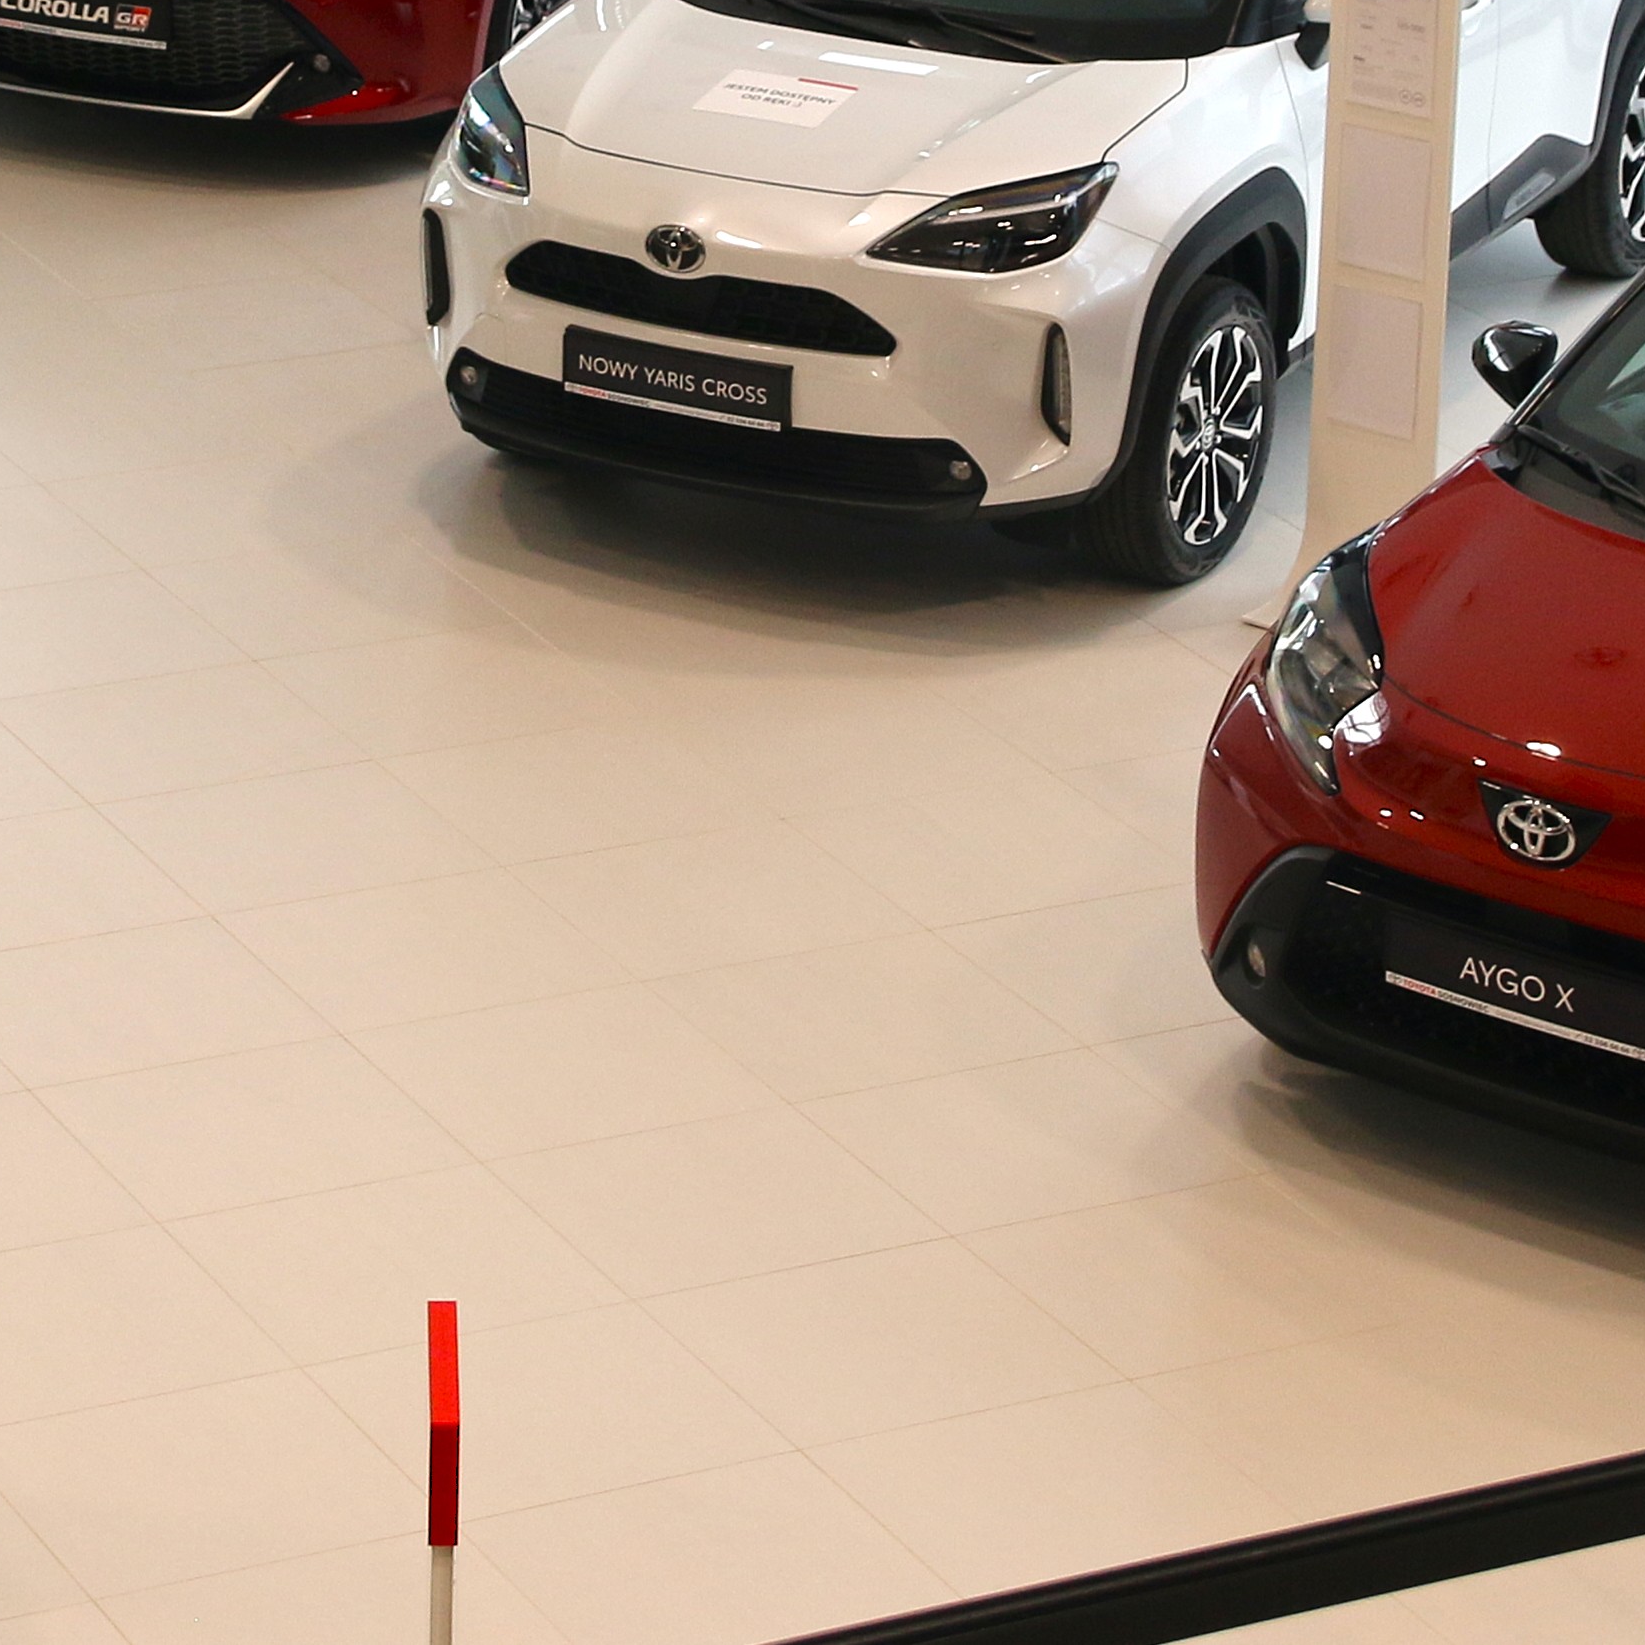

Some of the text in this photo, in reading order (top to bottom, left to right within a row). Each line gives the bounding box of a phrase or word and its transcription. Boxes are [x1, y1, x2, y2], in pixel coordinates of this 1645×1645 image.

[724, 82, 837, 105] JESTEM DOSTĘPNY
[741, 93, 762, 101] OD
[579, 354, 767, 405] NOWY YARIS CROSS
[1404, 979, 1437, 997] TOYOTA
[1459, 957, 1575, 1012] AYGO X
